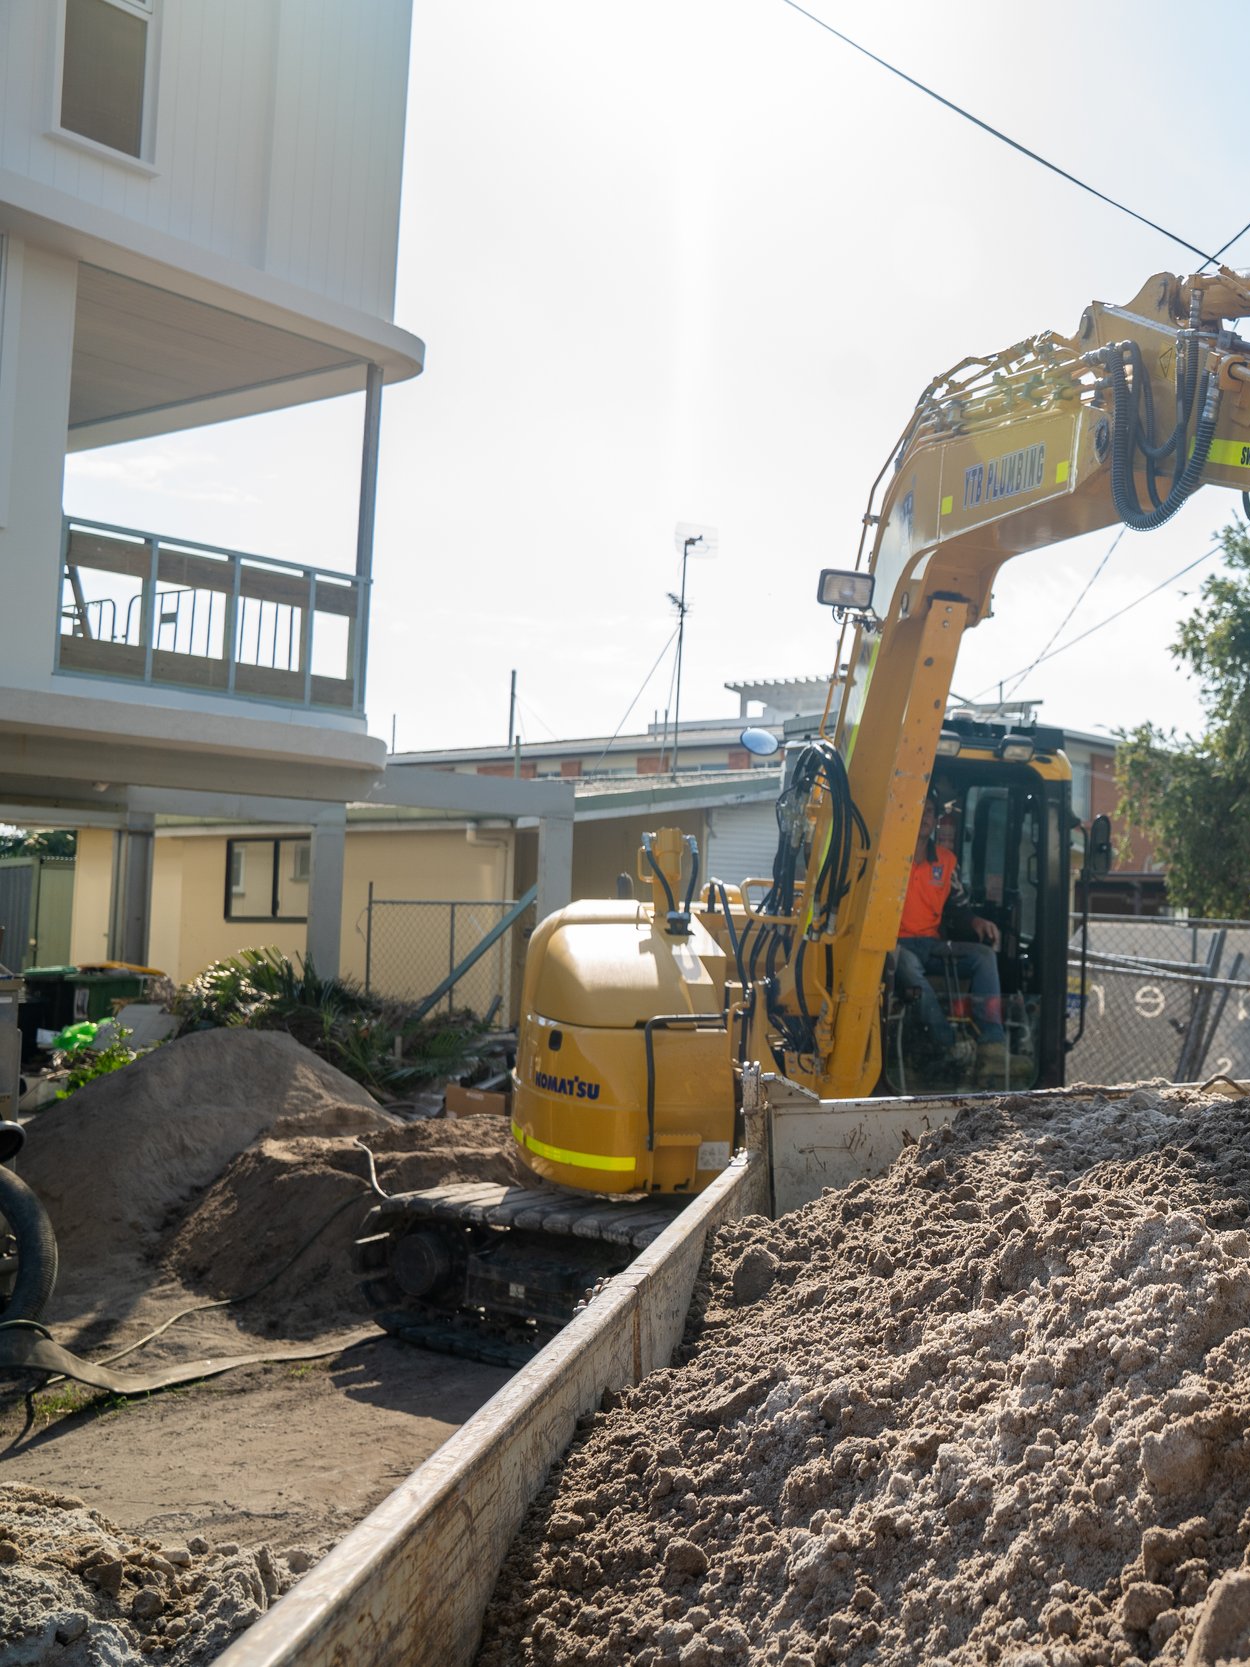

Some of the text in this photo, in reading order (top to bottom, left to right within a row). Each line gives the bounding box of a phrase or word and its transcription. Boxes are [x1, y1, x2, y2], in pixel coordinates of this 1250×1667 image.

[963, 441, 1046, 511] YTB PLUMBING
[535, 1071, 600, 1100] KOMATSU
